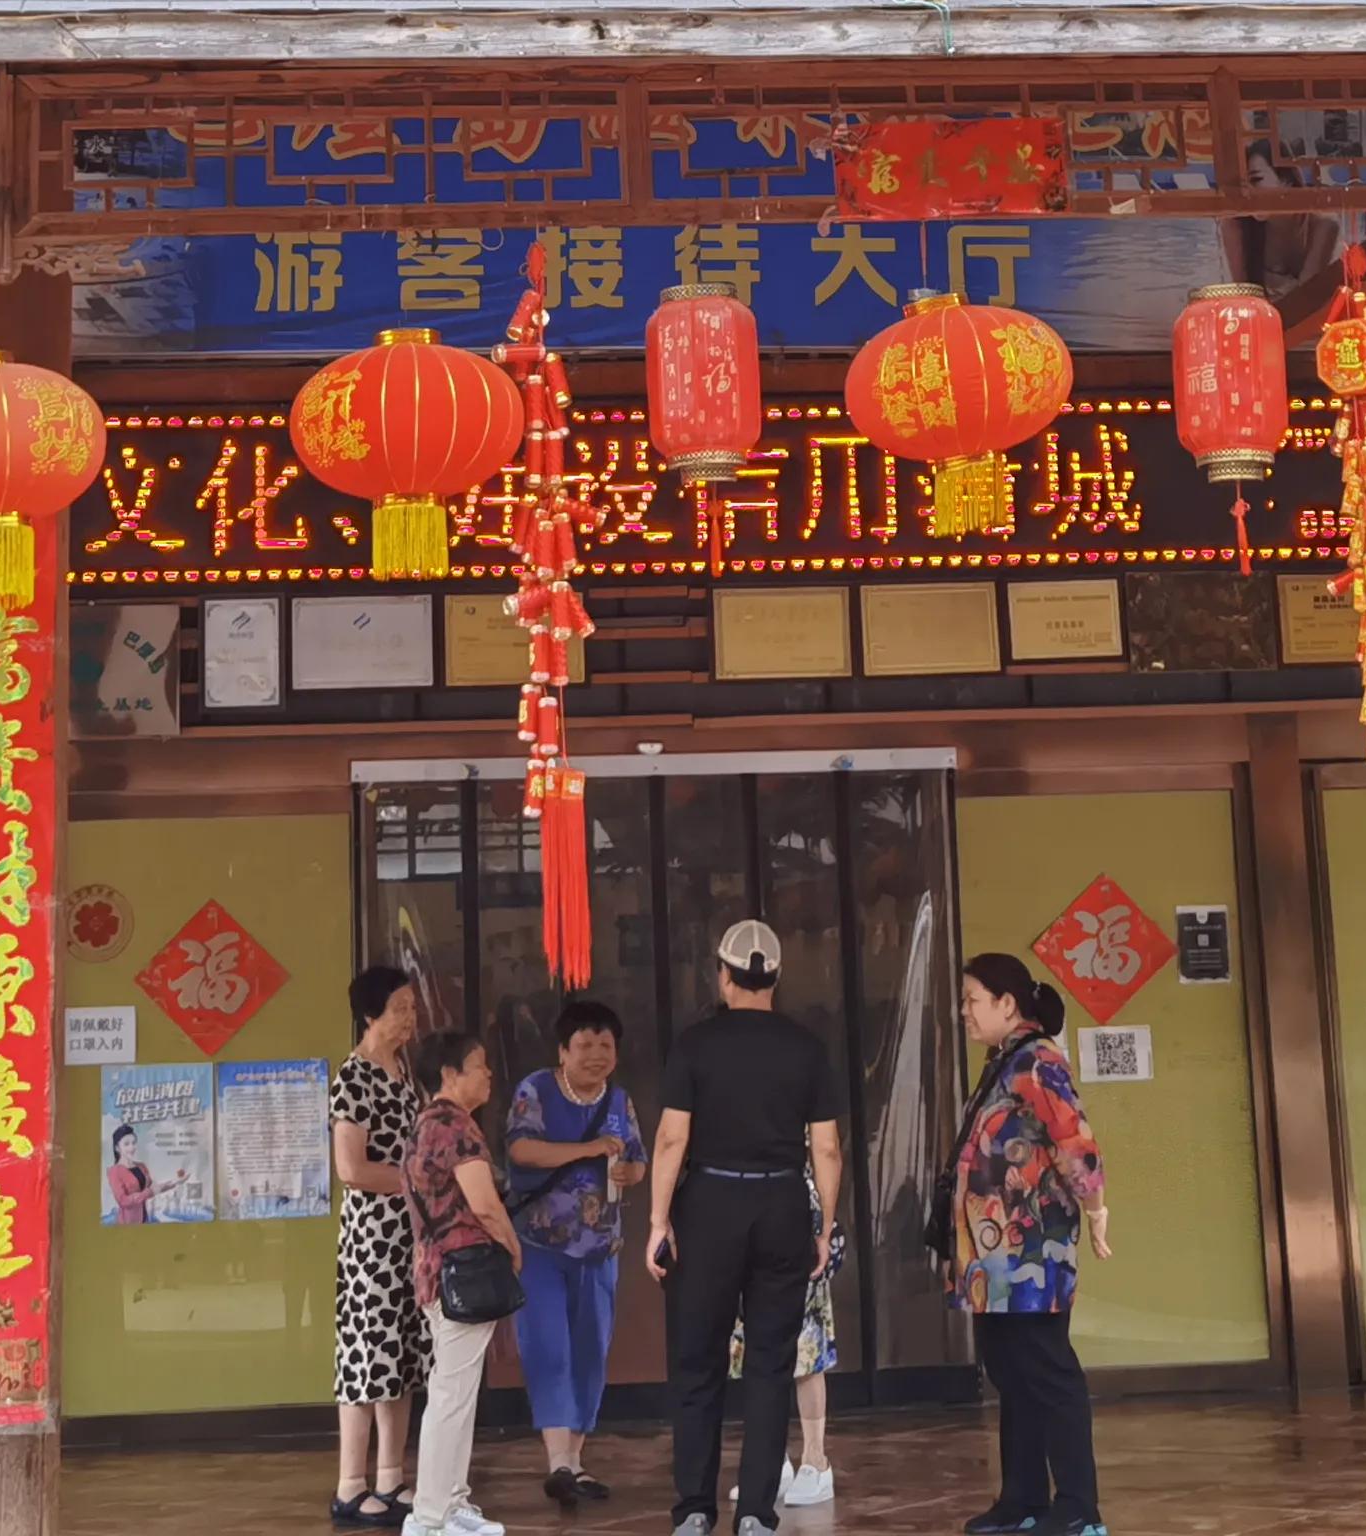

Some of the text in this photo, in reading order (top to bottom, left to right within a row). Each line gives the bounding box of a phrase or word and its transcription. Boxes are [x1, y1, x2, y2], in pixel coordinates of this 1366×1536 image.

[254, 225, 1031, 312] 游客接待大厅
[167, 931, 251, 1014] 福
[1063, 904, 1142, 986] 福
[68, 1036, 124, 1052] 口罩入内
[69, 1017, 124, 1033] 请佩戴好
